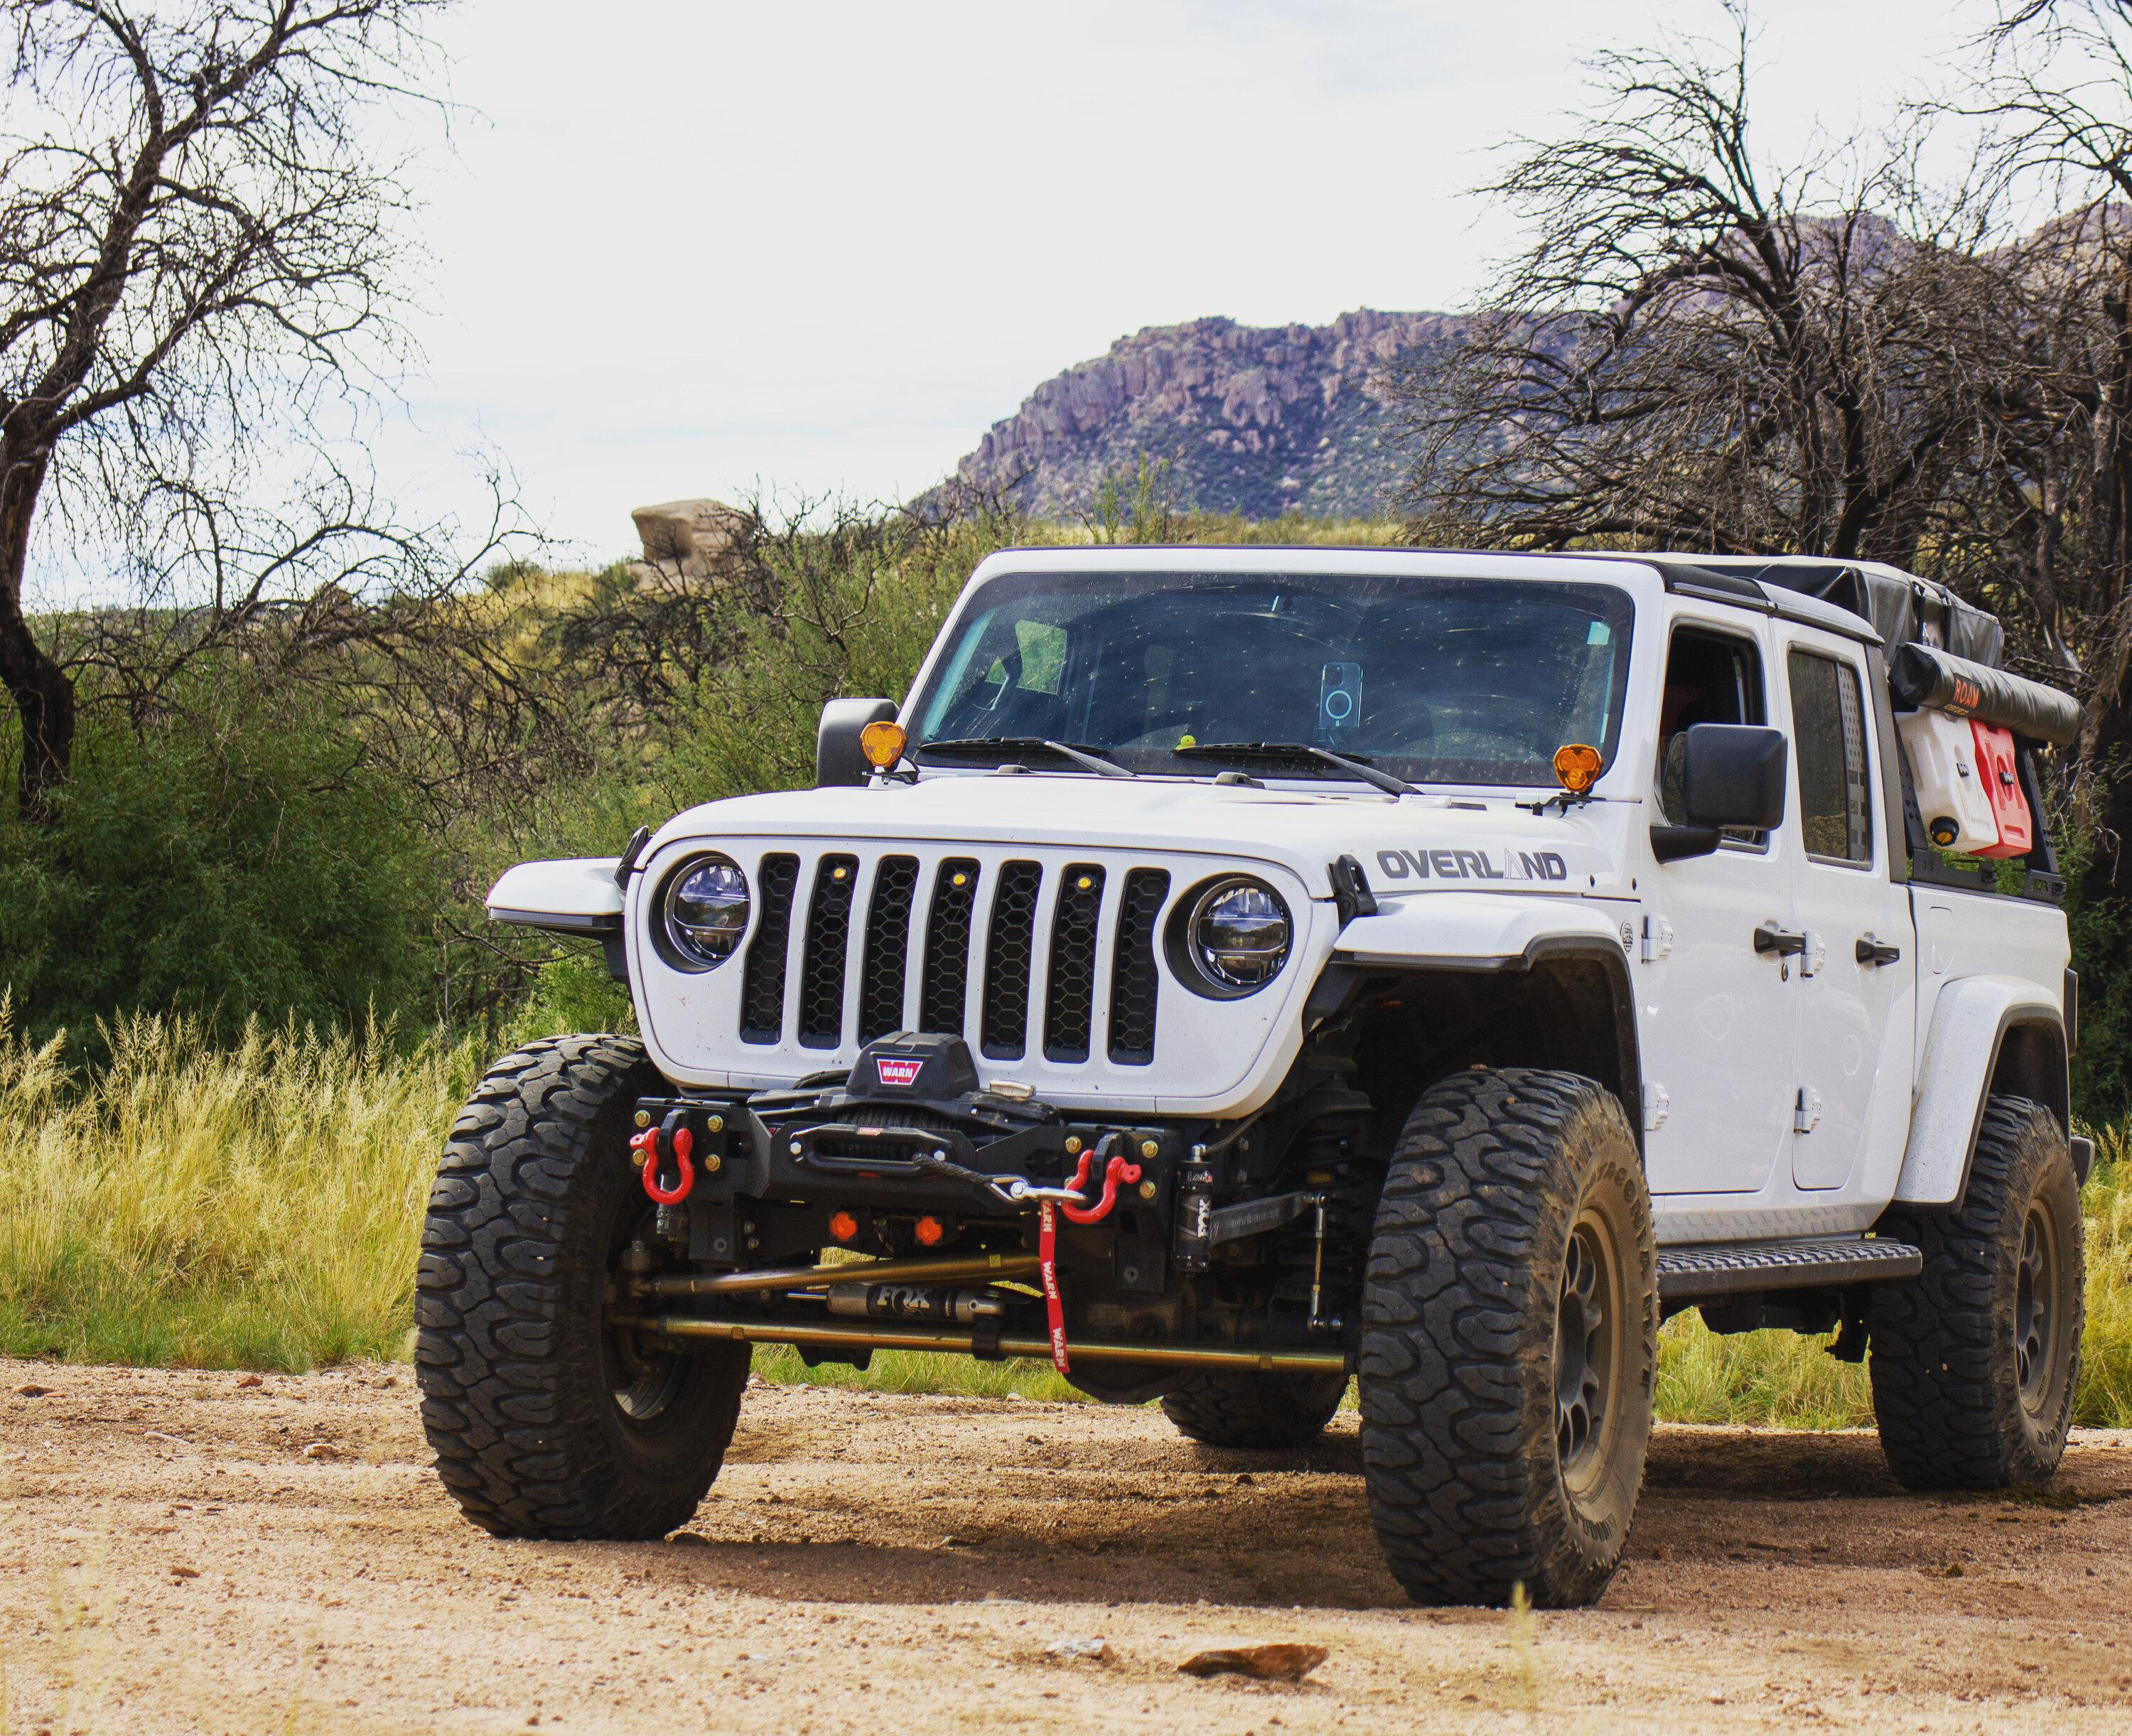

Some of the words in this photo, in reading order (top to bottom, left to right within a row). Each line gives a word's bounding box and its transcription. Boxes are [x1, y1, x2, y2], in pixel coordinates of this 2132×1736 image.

[1953, 678, 1979, 709] ROAM
[1377, 848, 1568, 880] OVERLAND
[883, 1066, 913, 1078] WARN
[1043, 1261, 1057, 1299] WARN
[876, 1285, 930, 1315] FOX
[1052, 1327, 1065, 1367] WARN
